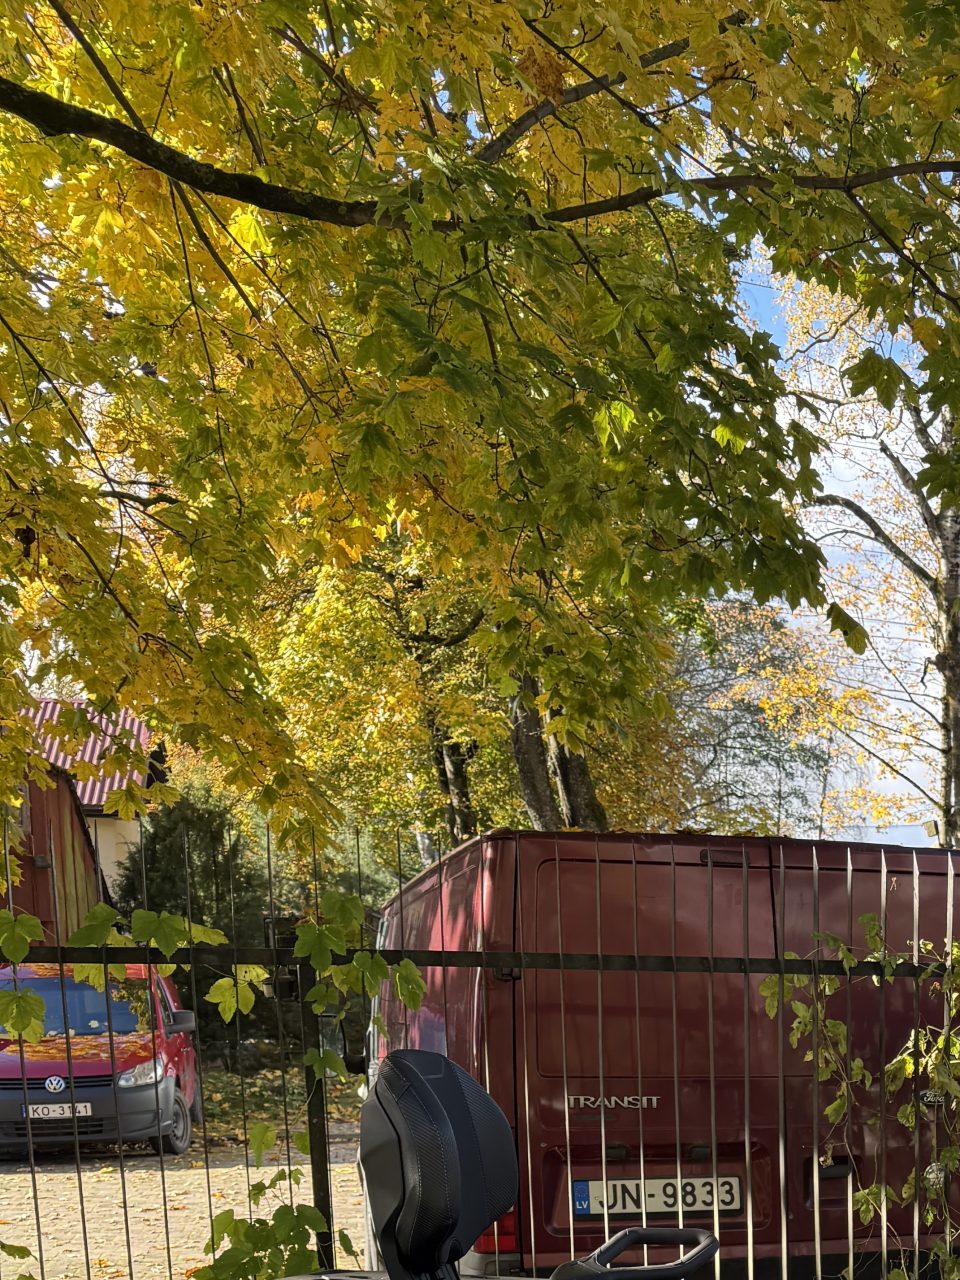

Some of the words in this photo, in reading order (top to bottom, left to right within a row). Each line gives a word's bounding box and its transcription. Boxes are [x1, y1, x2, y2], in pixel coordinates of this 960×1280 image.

[568, 1096, 661, 1109] TRANSIT
[598, 1181, 735, 1210] JN-9833
[576, 1200, 588, 1209] LV
